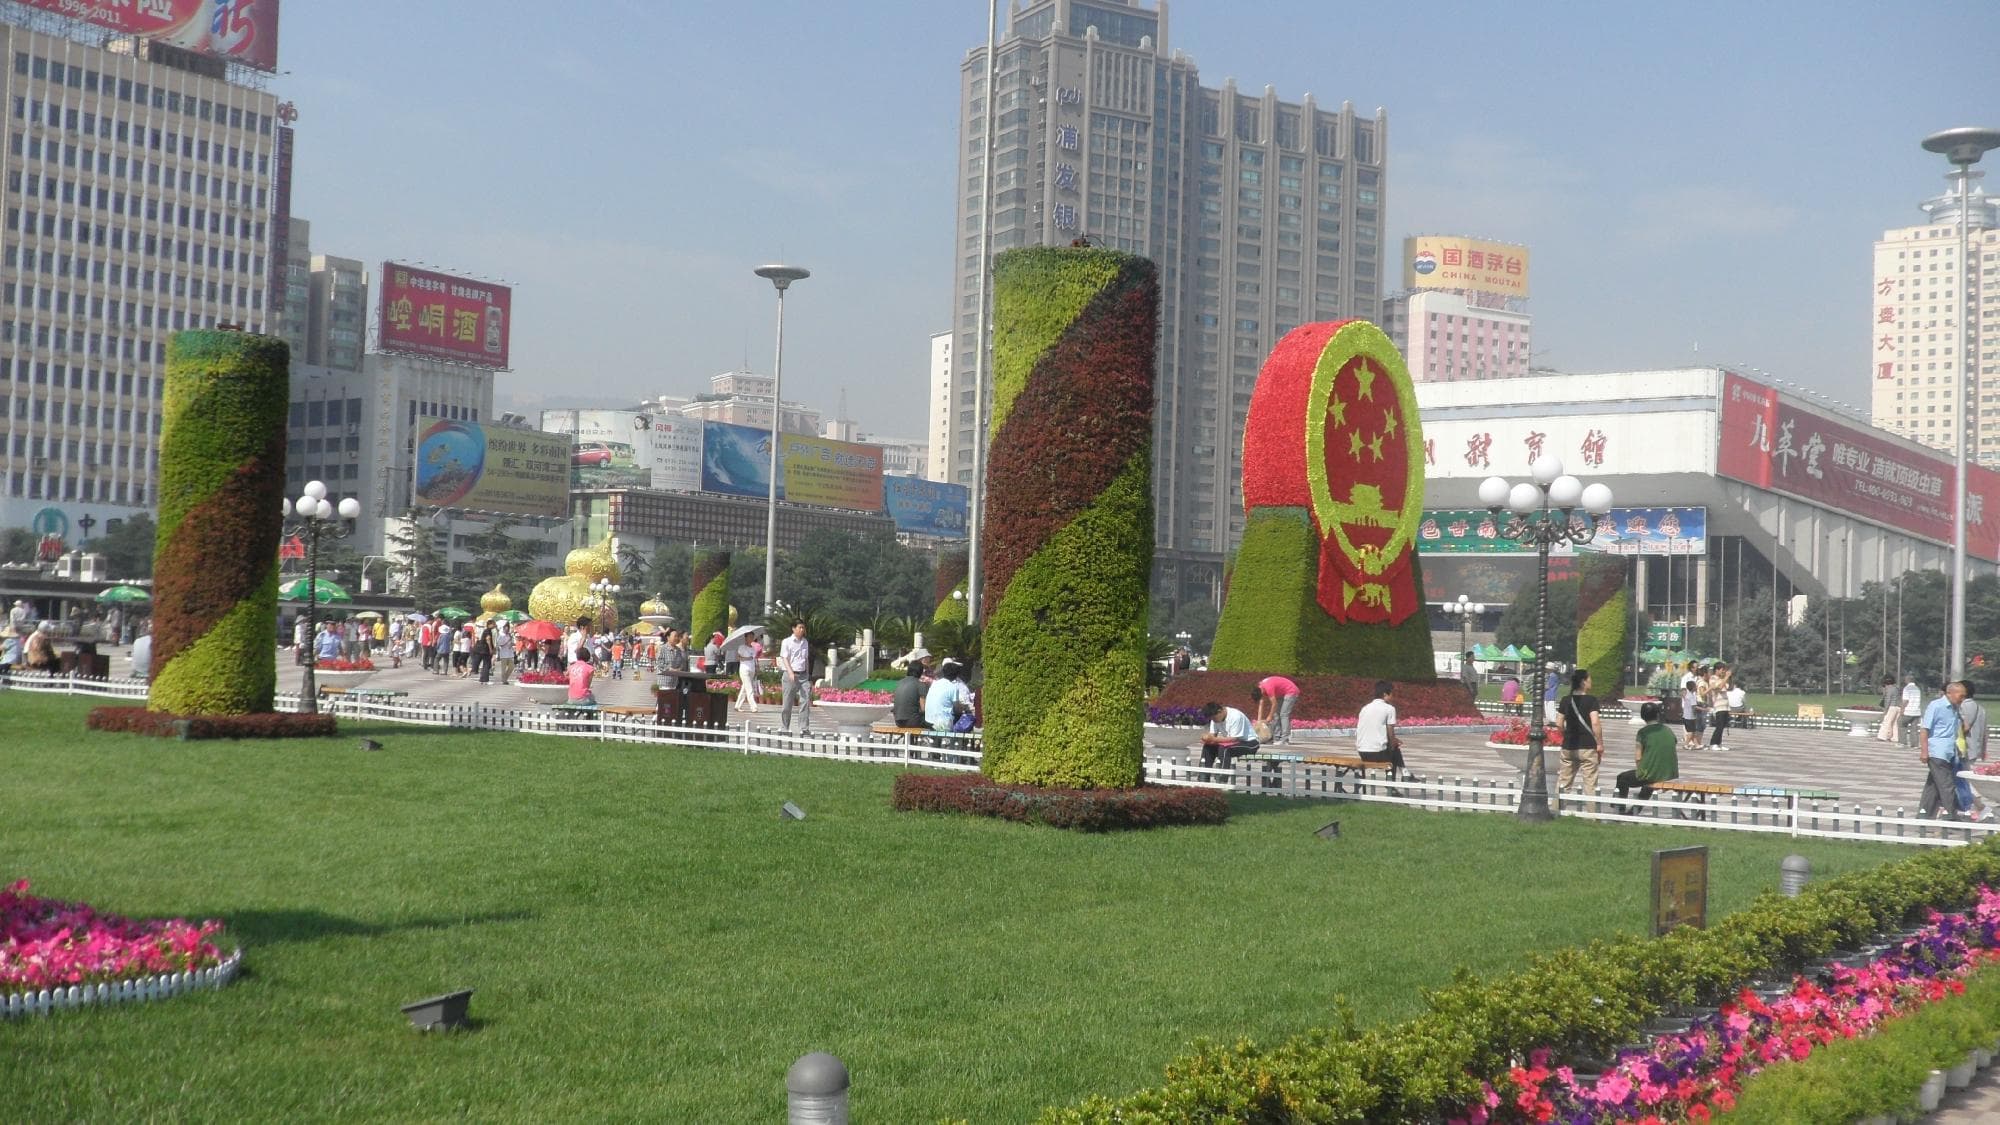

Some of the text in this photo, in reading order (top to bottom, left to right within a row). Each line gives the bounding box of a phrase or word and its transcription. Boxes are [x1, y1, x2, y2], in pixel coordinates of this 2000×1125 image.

[1443, 248, 1522, 275] 国酒茅台
[1441, 271, 1521, 289] CHINA MOUTAI
[387, 294, 480, 342] 崆峒酒
